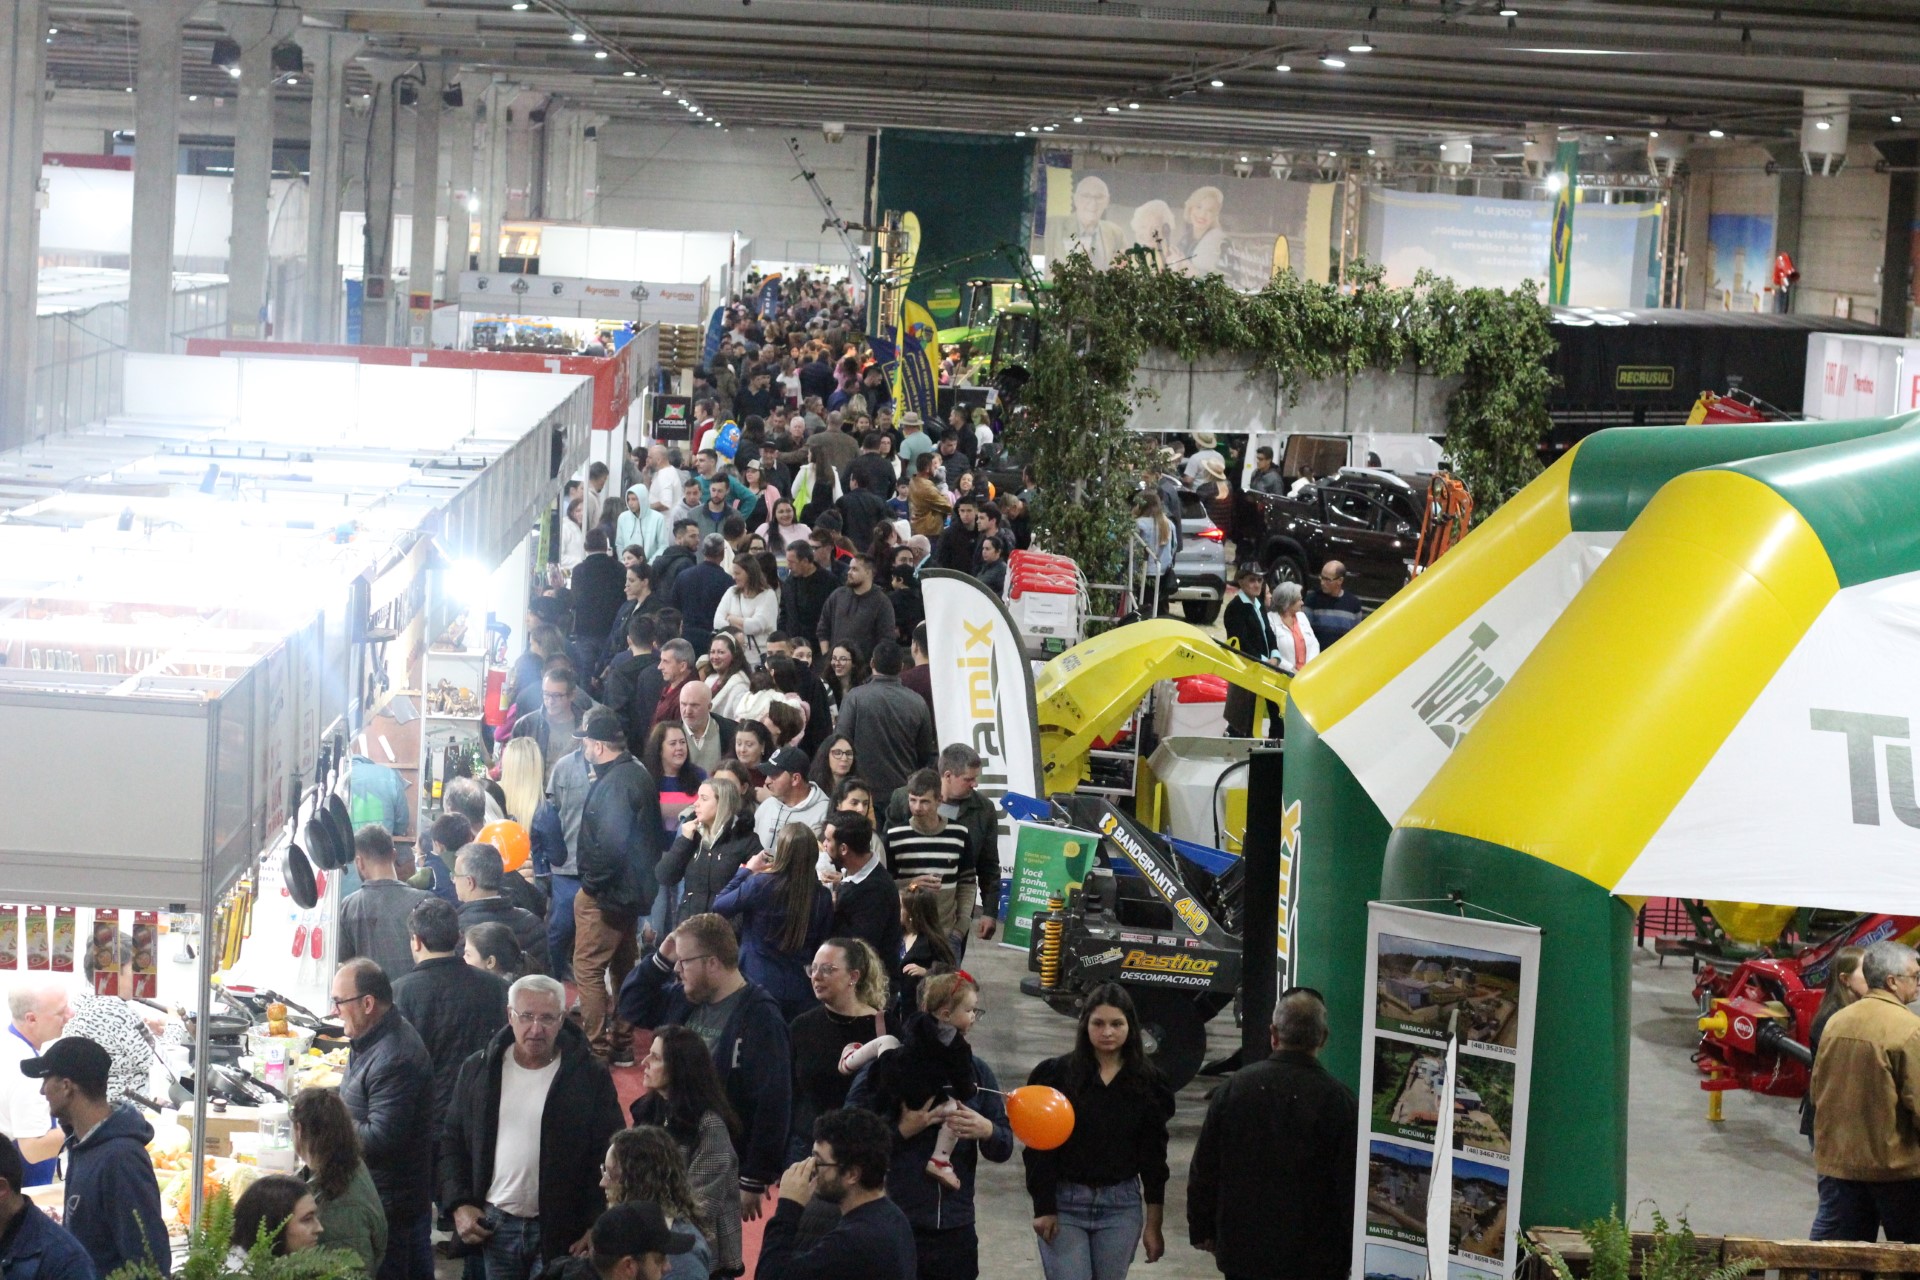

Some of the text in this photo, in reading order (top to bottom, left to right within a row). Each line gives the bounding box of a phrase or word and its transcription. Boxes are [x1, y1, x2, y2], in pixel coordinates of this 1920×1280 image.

[1619, 371, 1670, 385] RECRUSUL
[1113, 826, 1178, 899] BANDEIRANTE
[1022, 867, 1043, 878] Você
[1020, 877, 1048, 889] sonha,
[1017, 892, 1049, 905] financi
[1027, 887, 1050, 898] gente
[1173, 896, 1209, 936] 4HD
[1123, 949, 1219, 973] Rasthor
[1120, 971, 1211, 987] DESCOMPACTADOR
[1400, 1023, 1431, 1035] MARACAJÁ
[1369, 1226, 1394, 1235] MATRIZ
